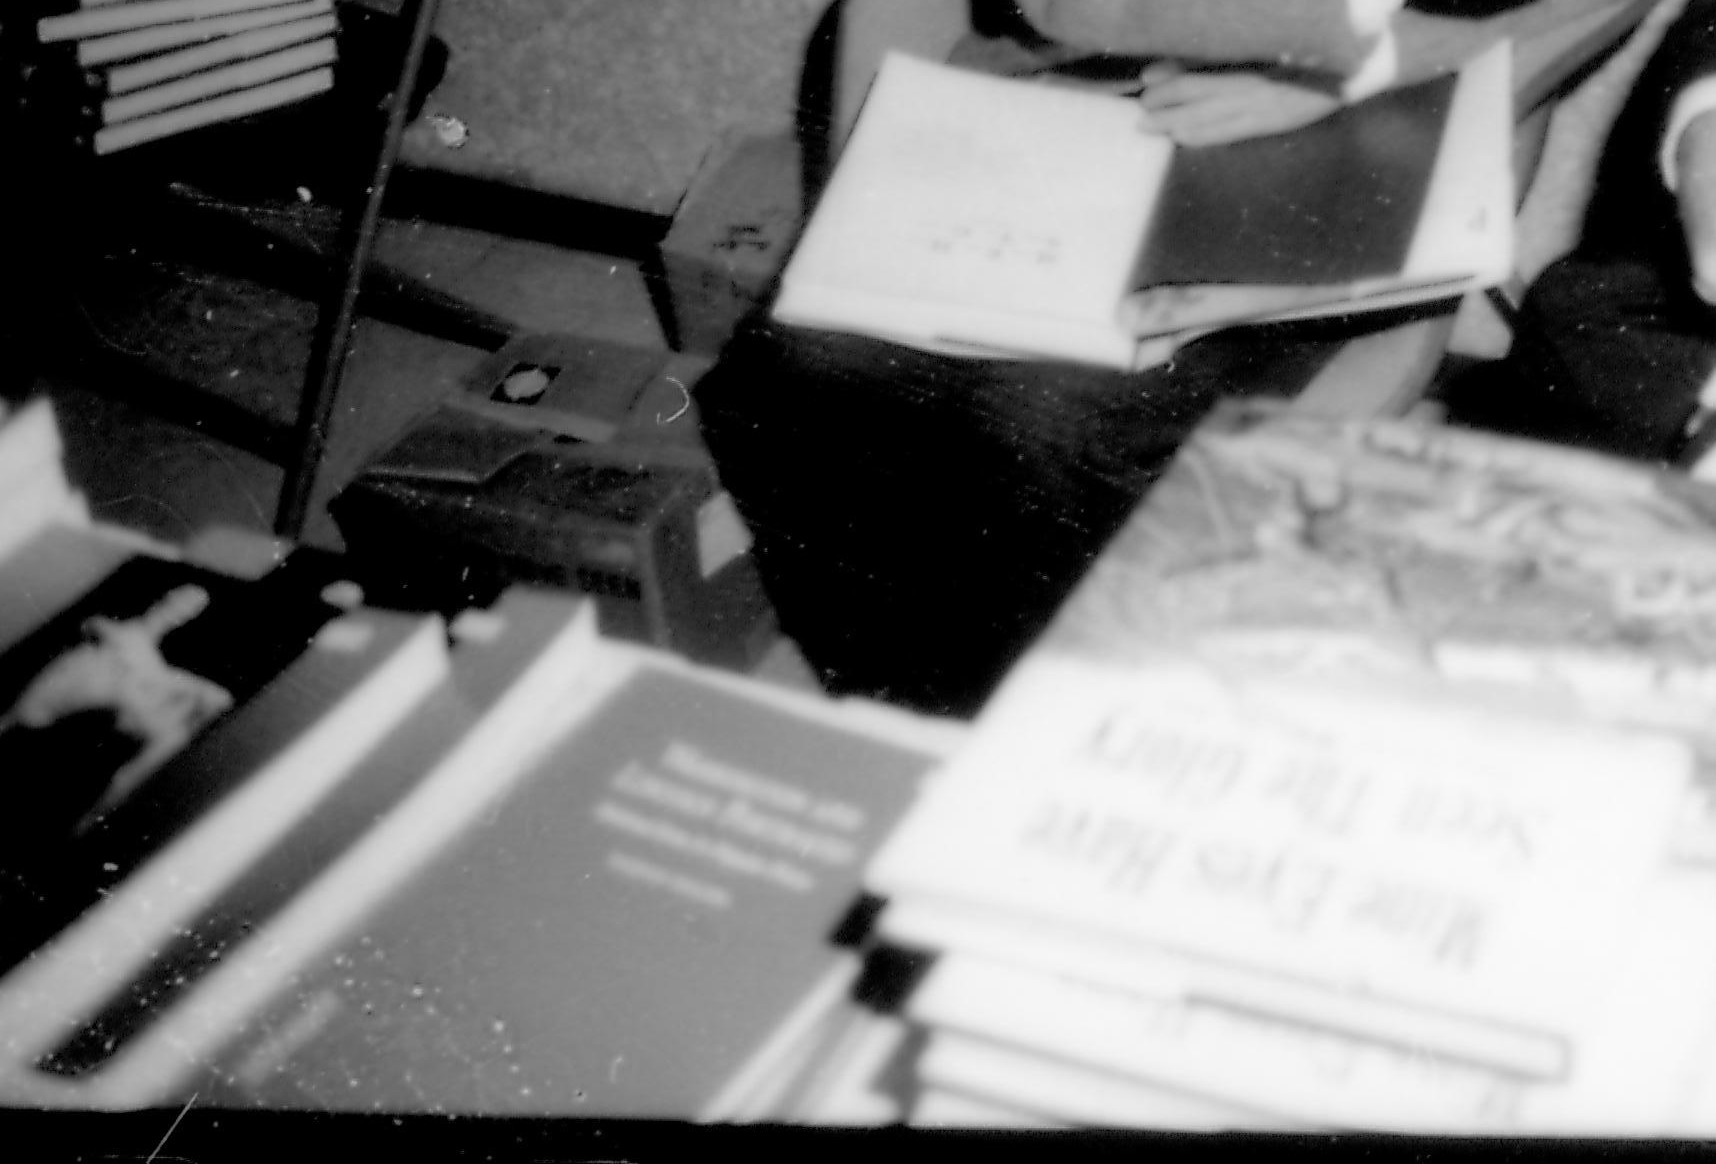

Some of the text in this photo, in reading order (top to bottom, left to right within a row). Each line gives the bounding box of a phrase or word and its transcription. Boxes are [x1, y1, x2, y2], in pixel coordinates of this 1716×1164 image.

[1072, 712, 1246, 807] Glory
[1260, 756, 1374, 835] The
[1395, 789, 1544, 864] Seen
[1018, 804, 1487, 971] Mine Eyes Have
